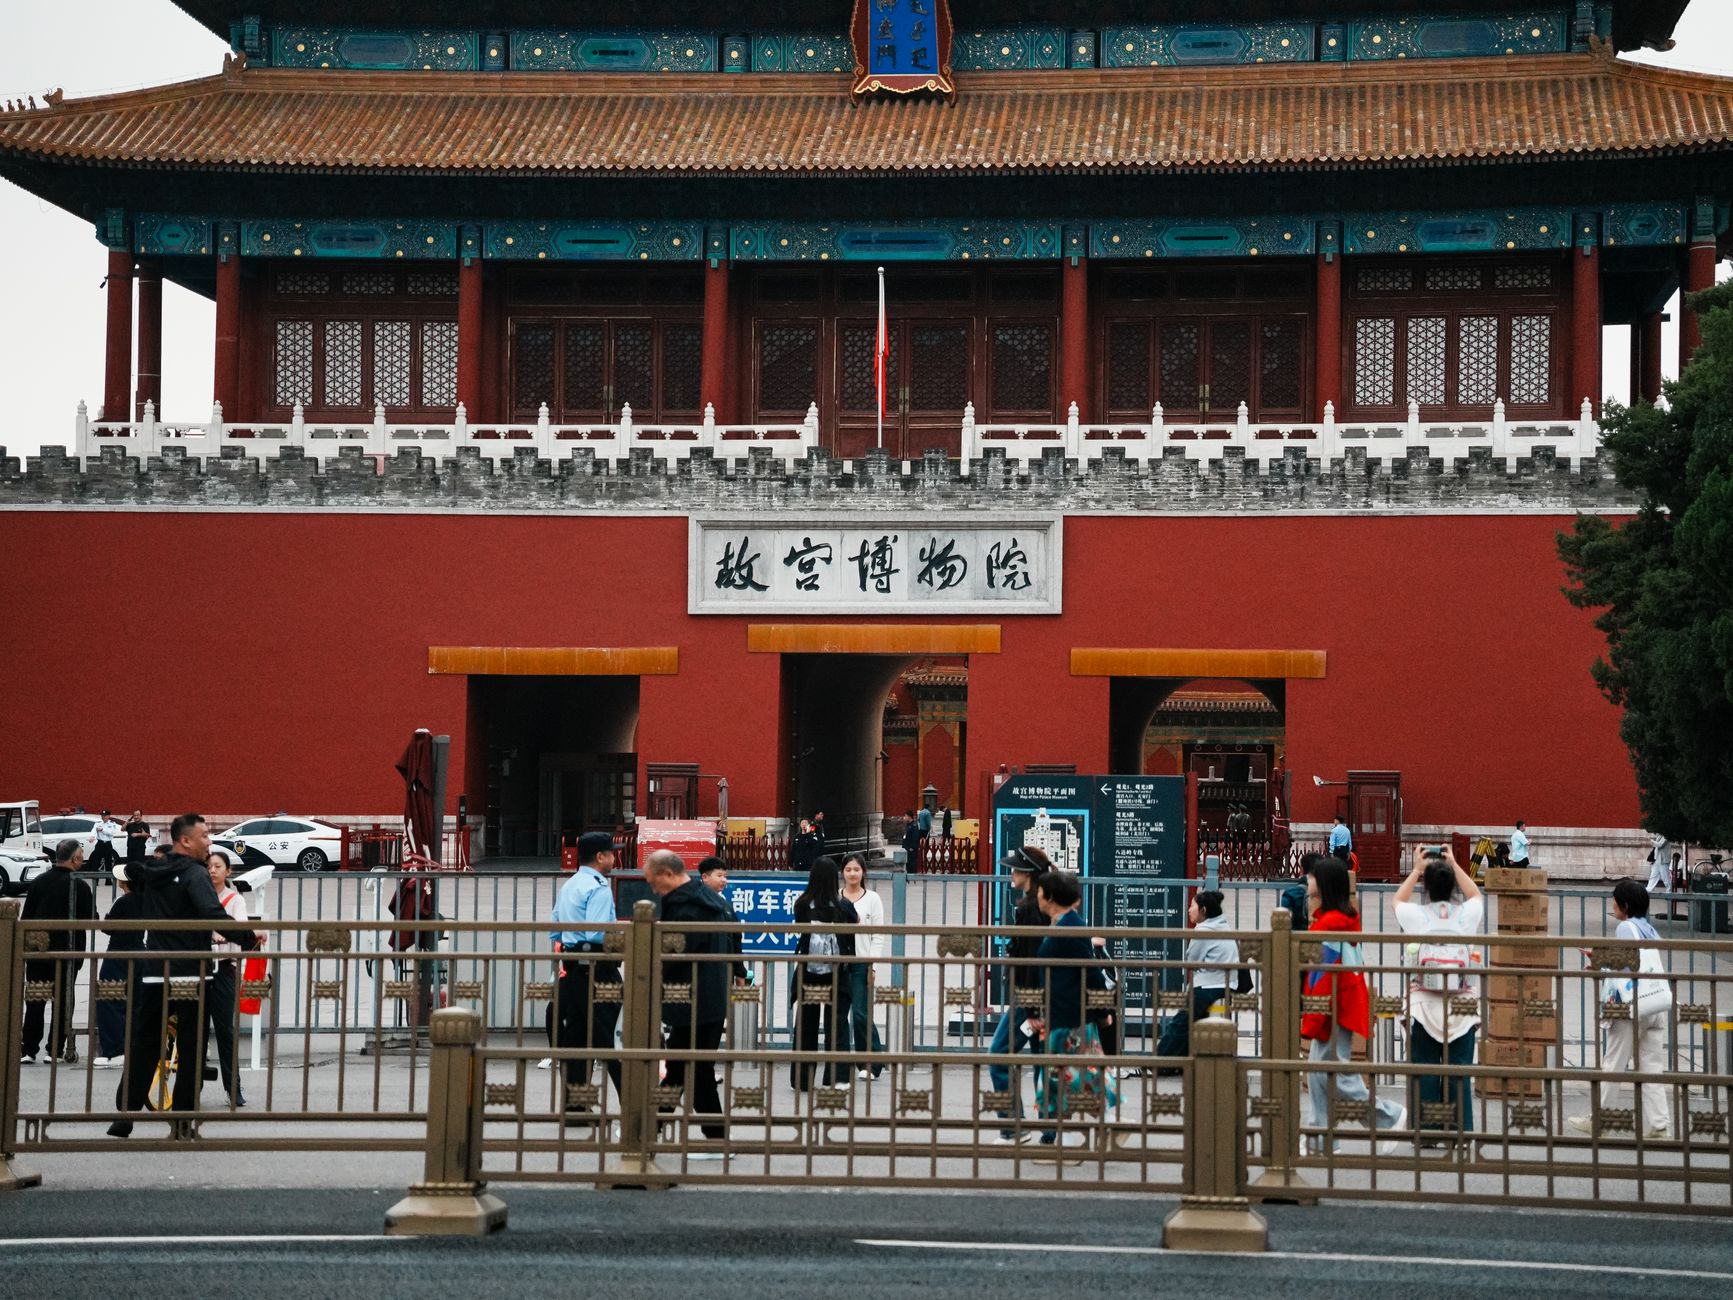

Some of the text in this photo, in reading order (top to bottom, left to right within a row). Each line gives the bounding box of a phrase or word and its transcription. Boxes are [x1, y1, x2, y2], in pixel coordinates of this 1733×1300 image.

[715, 535, 1032, 593] 故宫博物院
[1012, 786, 1076, 796] 故宫博物院平面图
[268, 841, 289, 850] 公安
